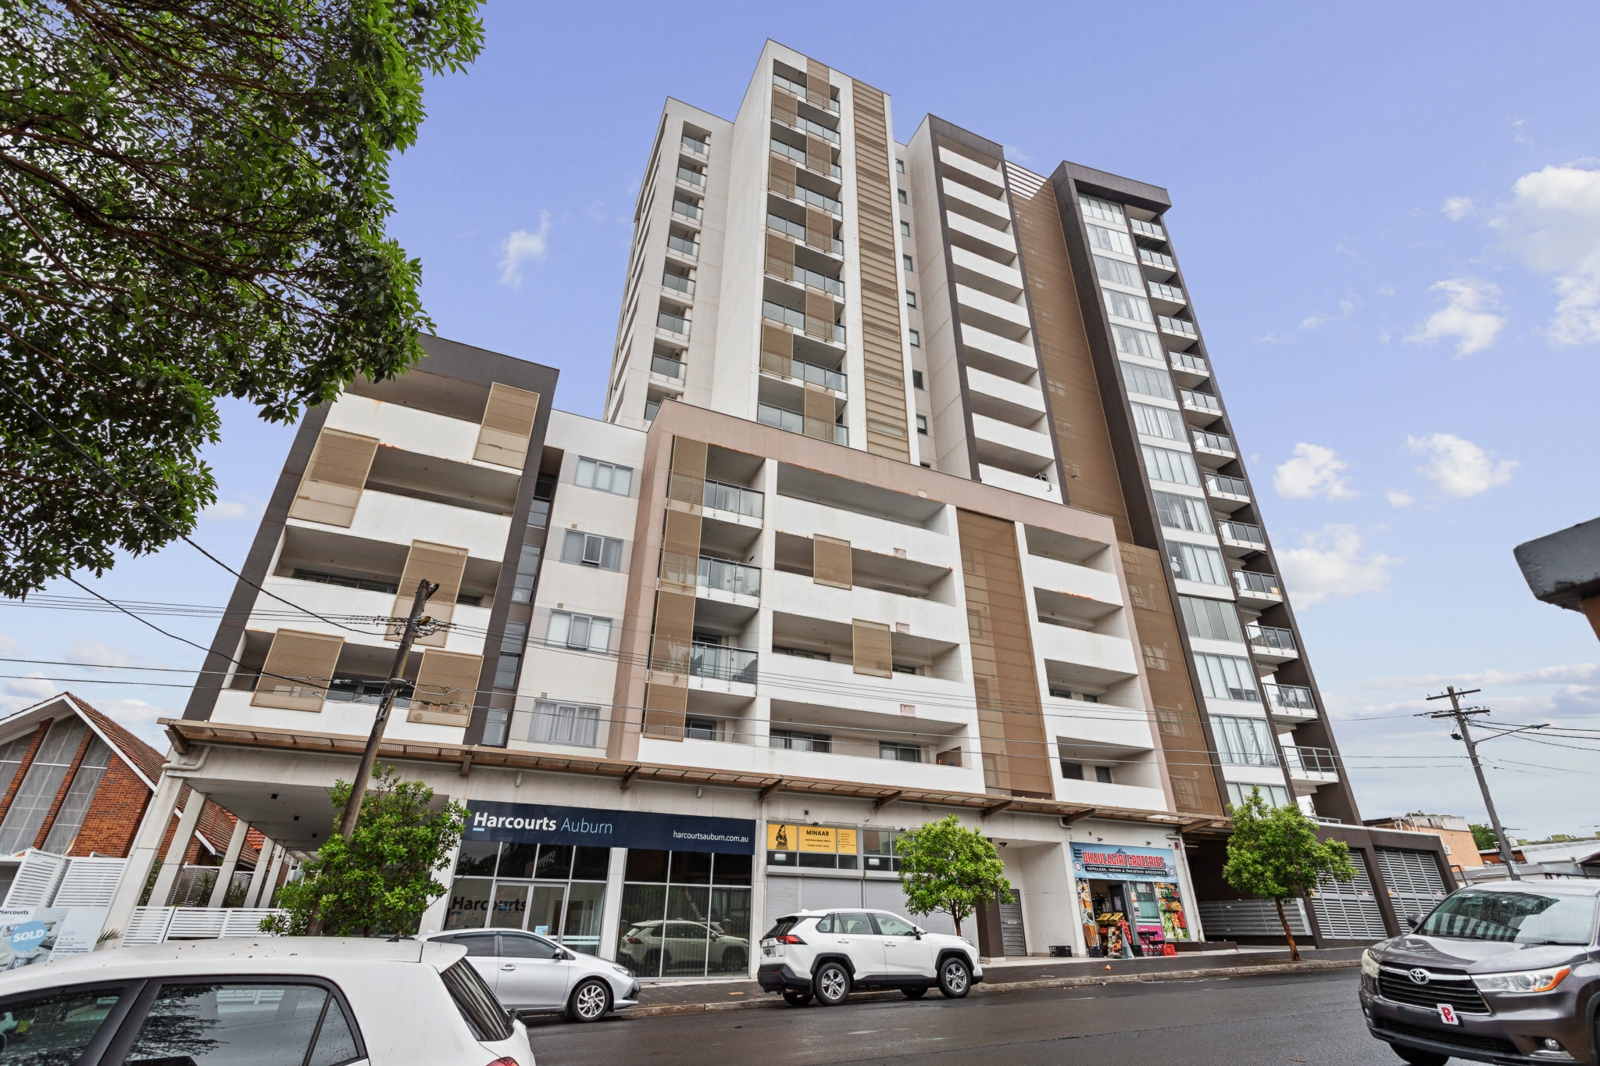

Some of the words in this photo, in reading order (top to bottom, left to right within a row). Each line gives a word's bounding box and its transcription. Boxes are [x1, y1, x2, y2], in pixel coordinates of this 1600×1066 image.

[473, 811, 557, 831] Harcourts
[560, 818, 613, 834] Auburn
[673, 830, 749, 843] harcourtsauburn.com.au
[806, 829, 830, 837] MINAAR
[1082, 851, 1127, 866] DHAULAGIRI
[1127, 854, 1165, 868] GROCERIES
[12, 929, 45, 943] SOLD
